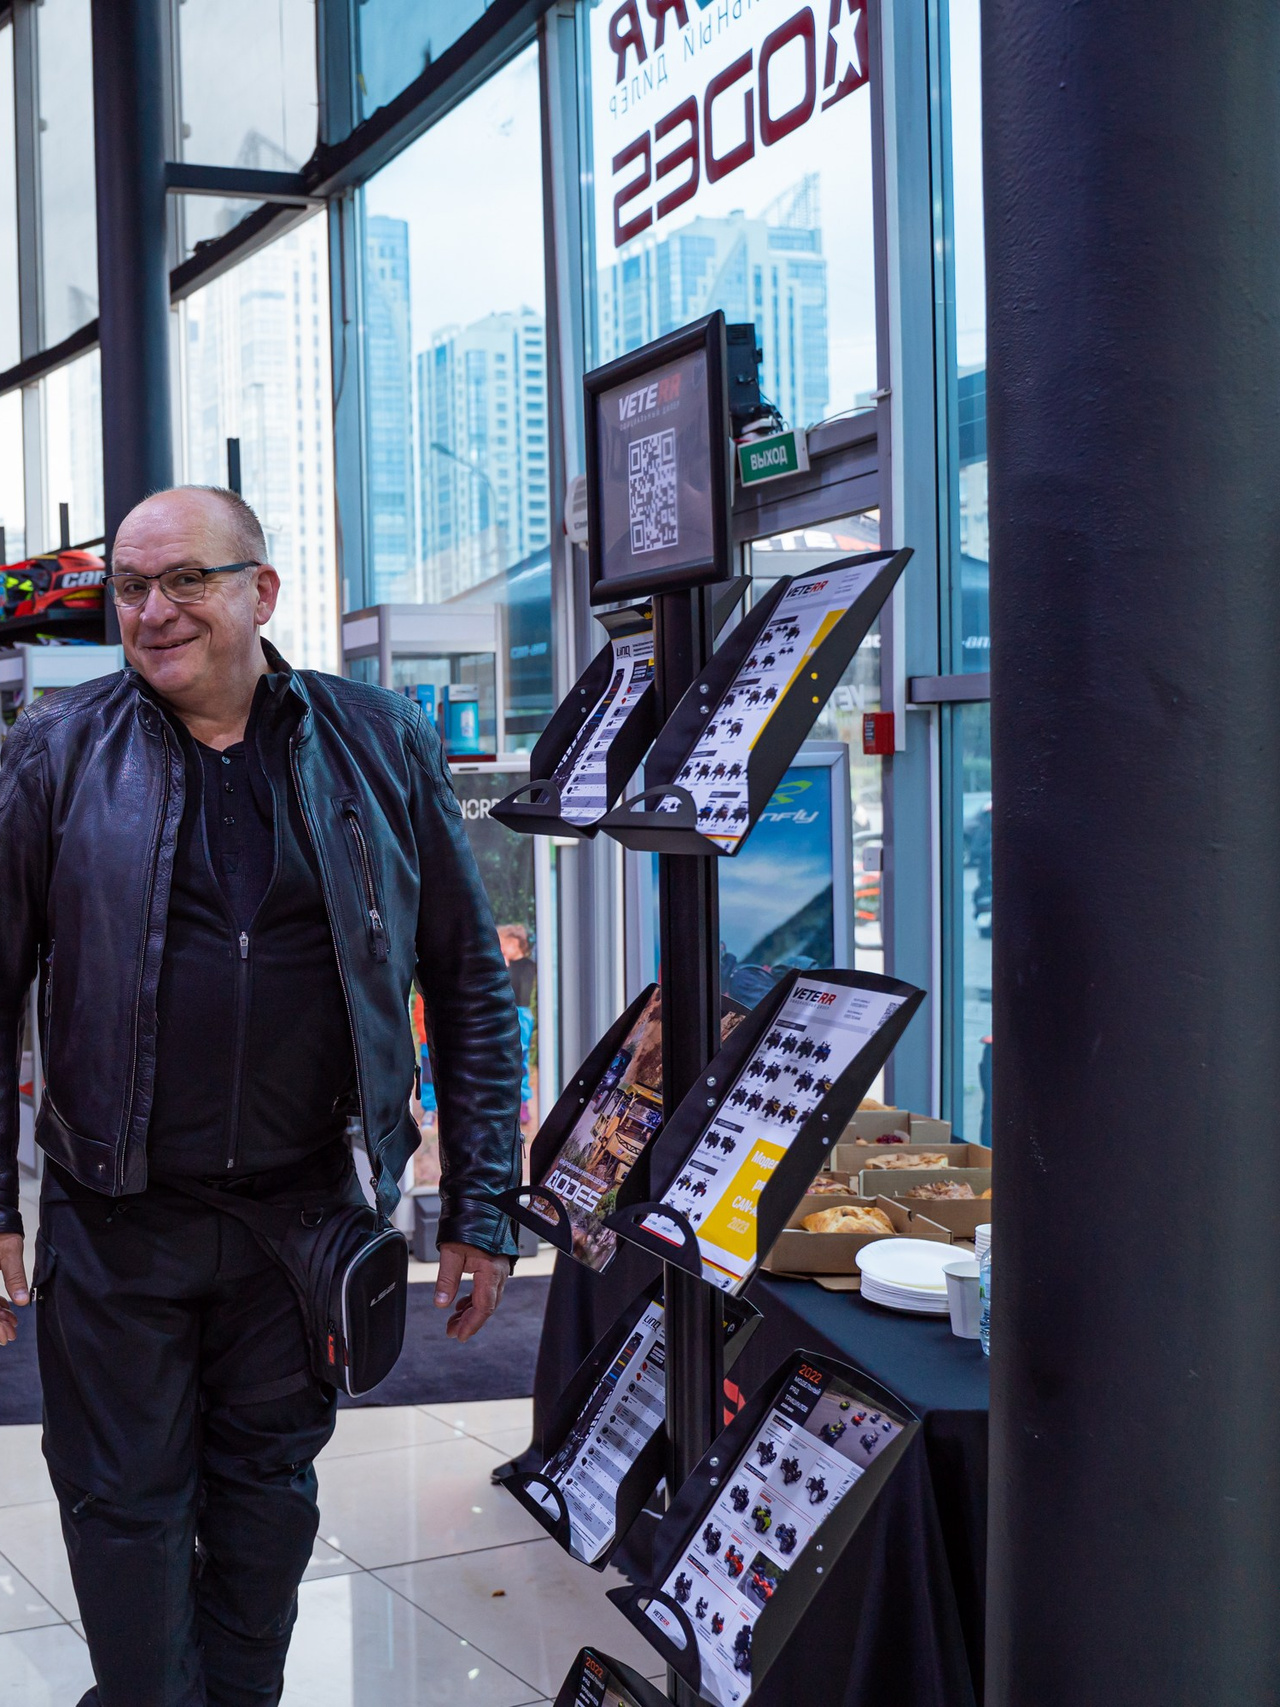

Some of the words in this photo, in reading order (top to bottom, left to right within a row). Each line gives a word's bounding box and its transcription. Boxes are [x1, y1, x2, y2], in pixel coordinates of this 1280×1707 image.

[618, 372, 682, 421] VETERR
[750, 445, 788, 471] ВЫХОД
[786, 579, 829, 598] VETERR
[791, 986, 837, 1006] VETERR
[544, 1169, 603, 1213] AODES
[732, 1195, 758, 1218] CAN-A
[798, 1364, 823, 1385] 2022
[585, 1656, 605, 1678] 2022
